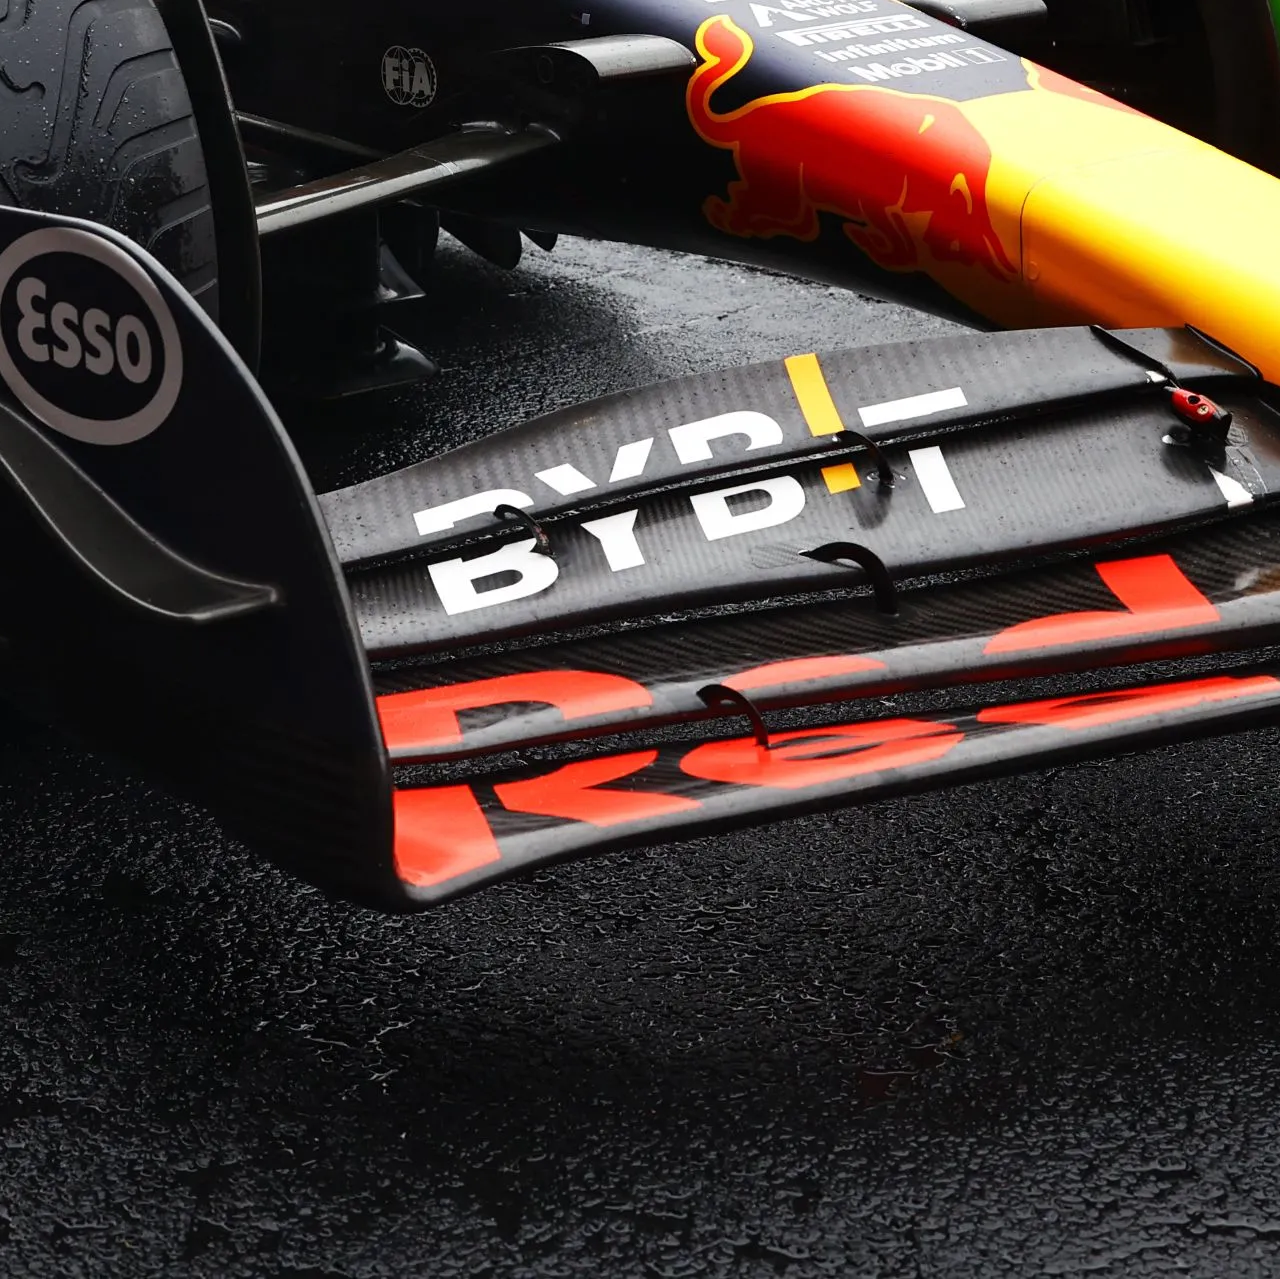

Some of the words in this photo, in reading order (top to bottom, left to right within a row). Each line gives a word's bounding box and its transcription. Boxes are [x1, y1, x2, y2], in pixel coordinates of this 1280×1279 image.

[811, 0, 880, 18] WOLF
[775, 13, 928, 47] PIRELLI
[814, 33, 967, 63] infinitum
[847, 50, 968, 83] Mobil
[15, 276, 153, 386] Esso
[412, 352, 968, 616] BYBIT
